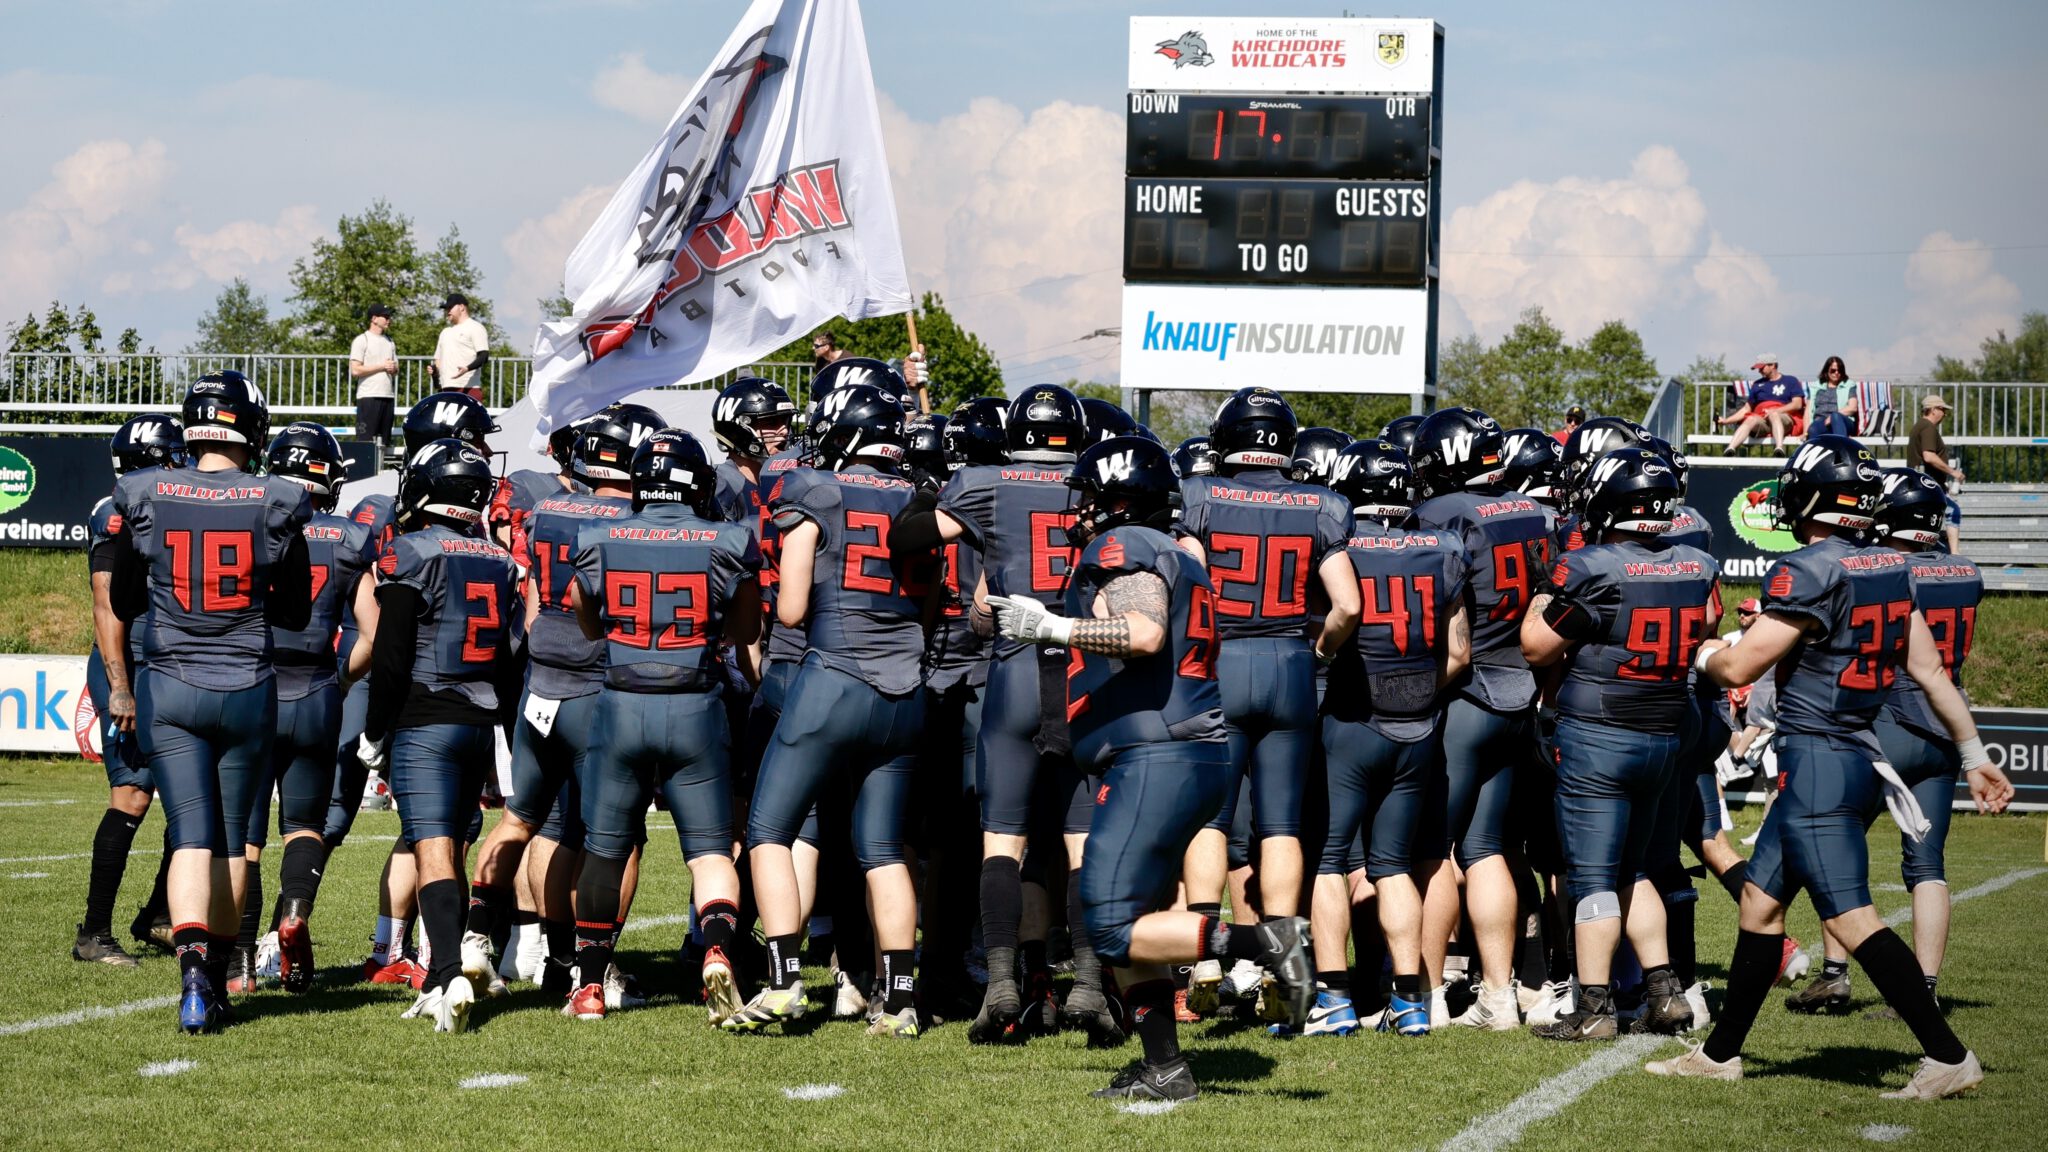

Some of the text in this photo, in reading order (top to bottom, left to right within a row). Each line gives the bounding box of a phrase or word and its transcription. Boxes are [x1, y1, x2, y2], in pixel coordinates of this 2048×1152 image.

[1256, 29, 1282, 37] HOME
[1300, 29, 1318, 37] THE
[1232, 40, 1346, 52] KIRCHDORF
[1231, 53, 1347, 68] WILDCATS
[1132, 95, 1415, 117] DOWN STRAMATEL QTR
[1136, 186, 1427, 217] HOME GUESTS
[1238, 244, 1308, 273] TO GO
[1248, 394, 1282, 406] siltronic
[1028, 405, 1062, 418] siltronic
[187, 429, 229, 440] Riddell
[1025, 430, 1035, 445] 6
[1256, 429, 1278, 446] 20
[587, 437, 599, 451] 17
[288, 447, 309, 463] 27
[652, 455, 666, 470] 51
[1241, 454, 1284, 466] Riddell
[1378, 458, 1407, 471] siltronic
[1388, 475, 1403, 489] 41
[156, 481, 266, 500] WILDCATS
[471, 490, 481, 503] 2
[639, 489, 682, 502] Riddell
[1210, 485, 1320, 506] WILDCATS
[539, 499, 622, 518] WILDCATS
[1474, 499, 1536, 518] WILDCATS
[1652, 499, 1670, 514] 98
[1857, 494, 1874, 510] 33
[608, 526, 720, 542] WILDCATS
[1348, 534, 1438, 550] WILDCATS
[439, 539, 510, 558] WILDCATS
[1625, 560, 1702, 577] WILDCATS
[1839, 552, 1907, 571] WILDCATS
[165, 530, 253, 613] 18
[1209, 533, 1314, 618] 20
[1910, 565, 1977, 578] WILDCATS
[604, 569, 710, 651] 93
[1361, 574, 1436, 656] 41
[462, 581, 501, 663] 2
